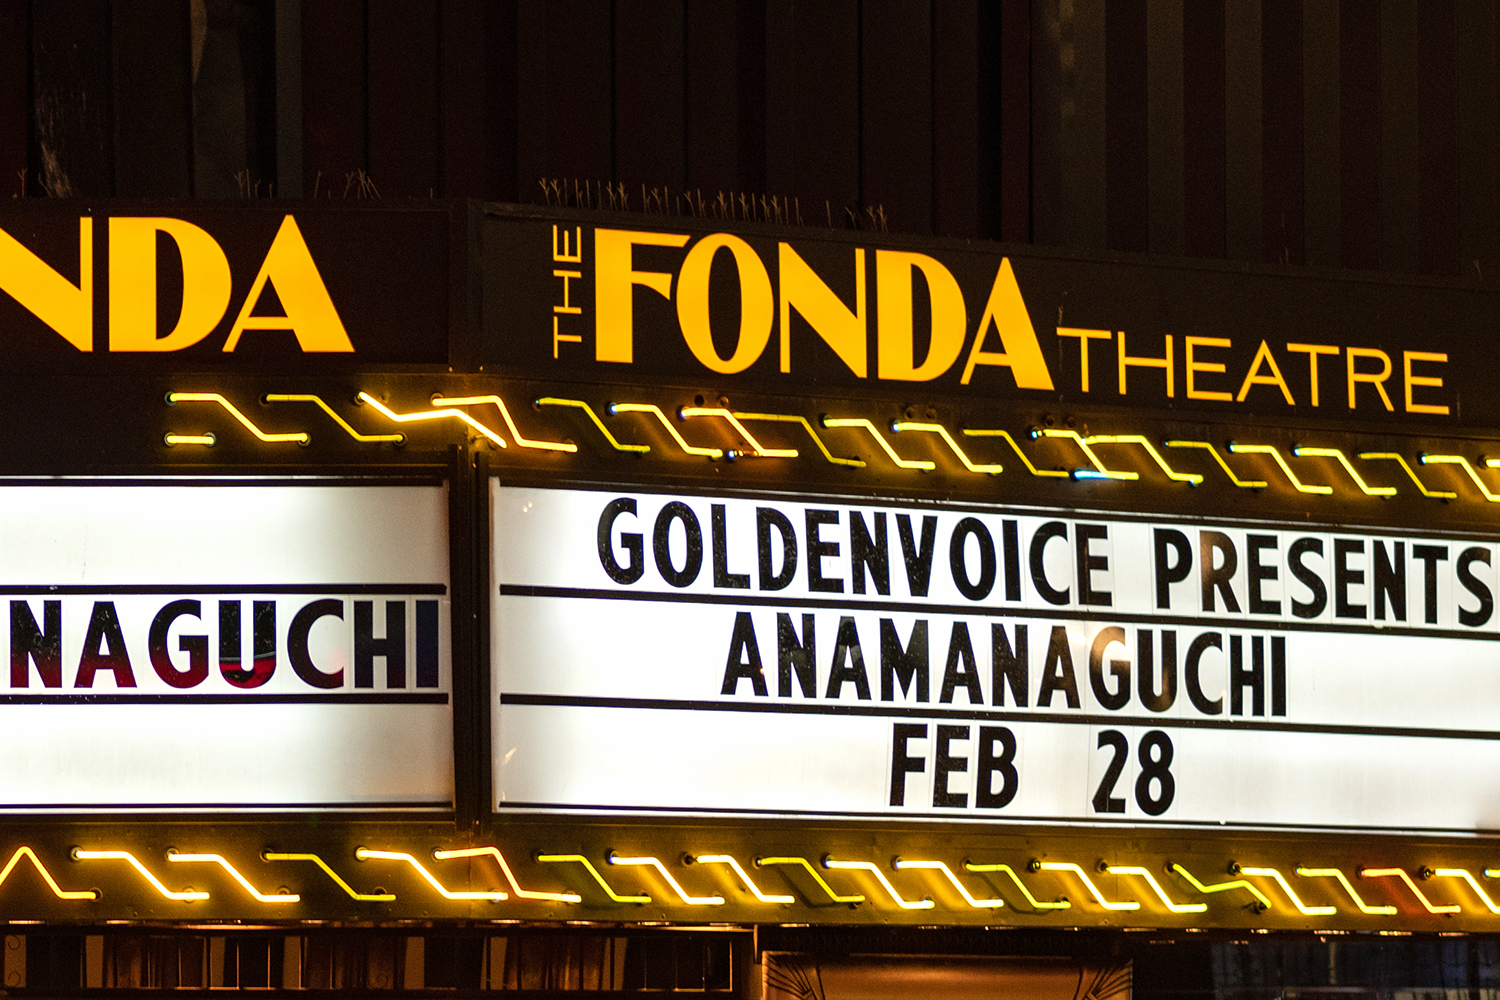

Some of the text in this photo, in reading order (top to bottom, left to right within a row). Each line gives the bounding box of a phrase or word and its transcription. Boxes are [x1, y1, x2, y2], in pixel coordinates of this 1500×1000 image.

[552, 224, 1450, 415] THE FONDA THEATRE
[597, 497, 1495, 628] GOLDENVOICE PRESENTS
[720, 611, 1288, 718] ANAMANAGUCHI
[889, 724, 1176, 817] FEB 28
